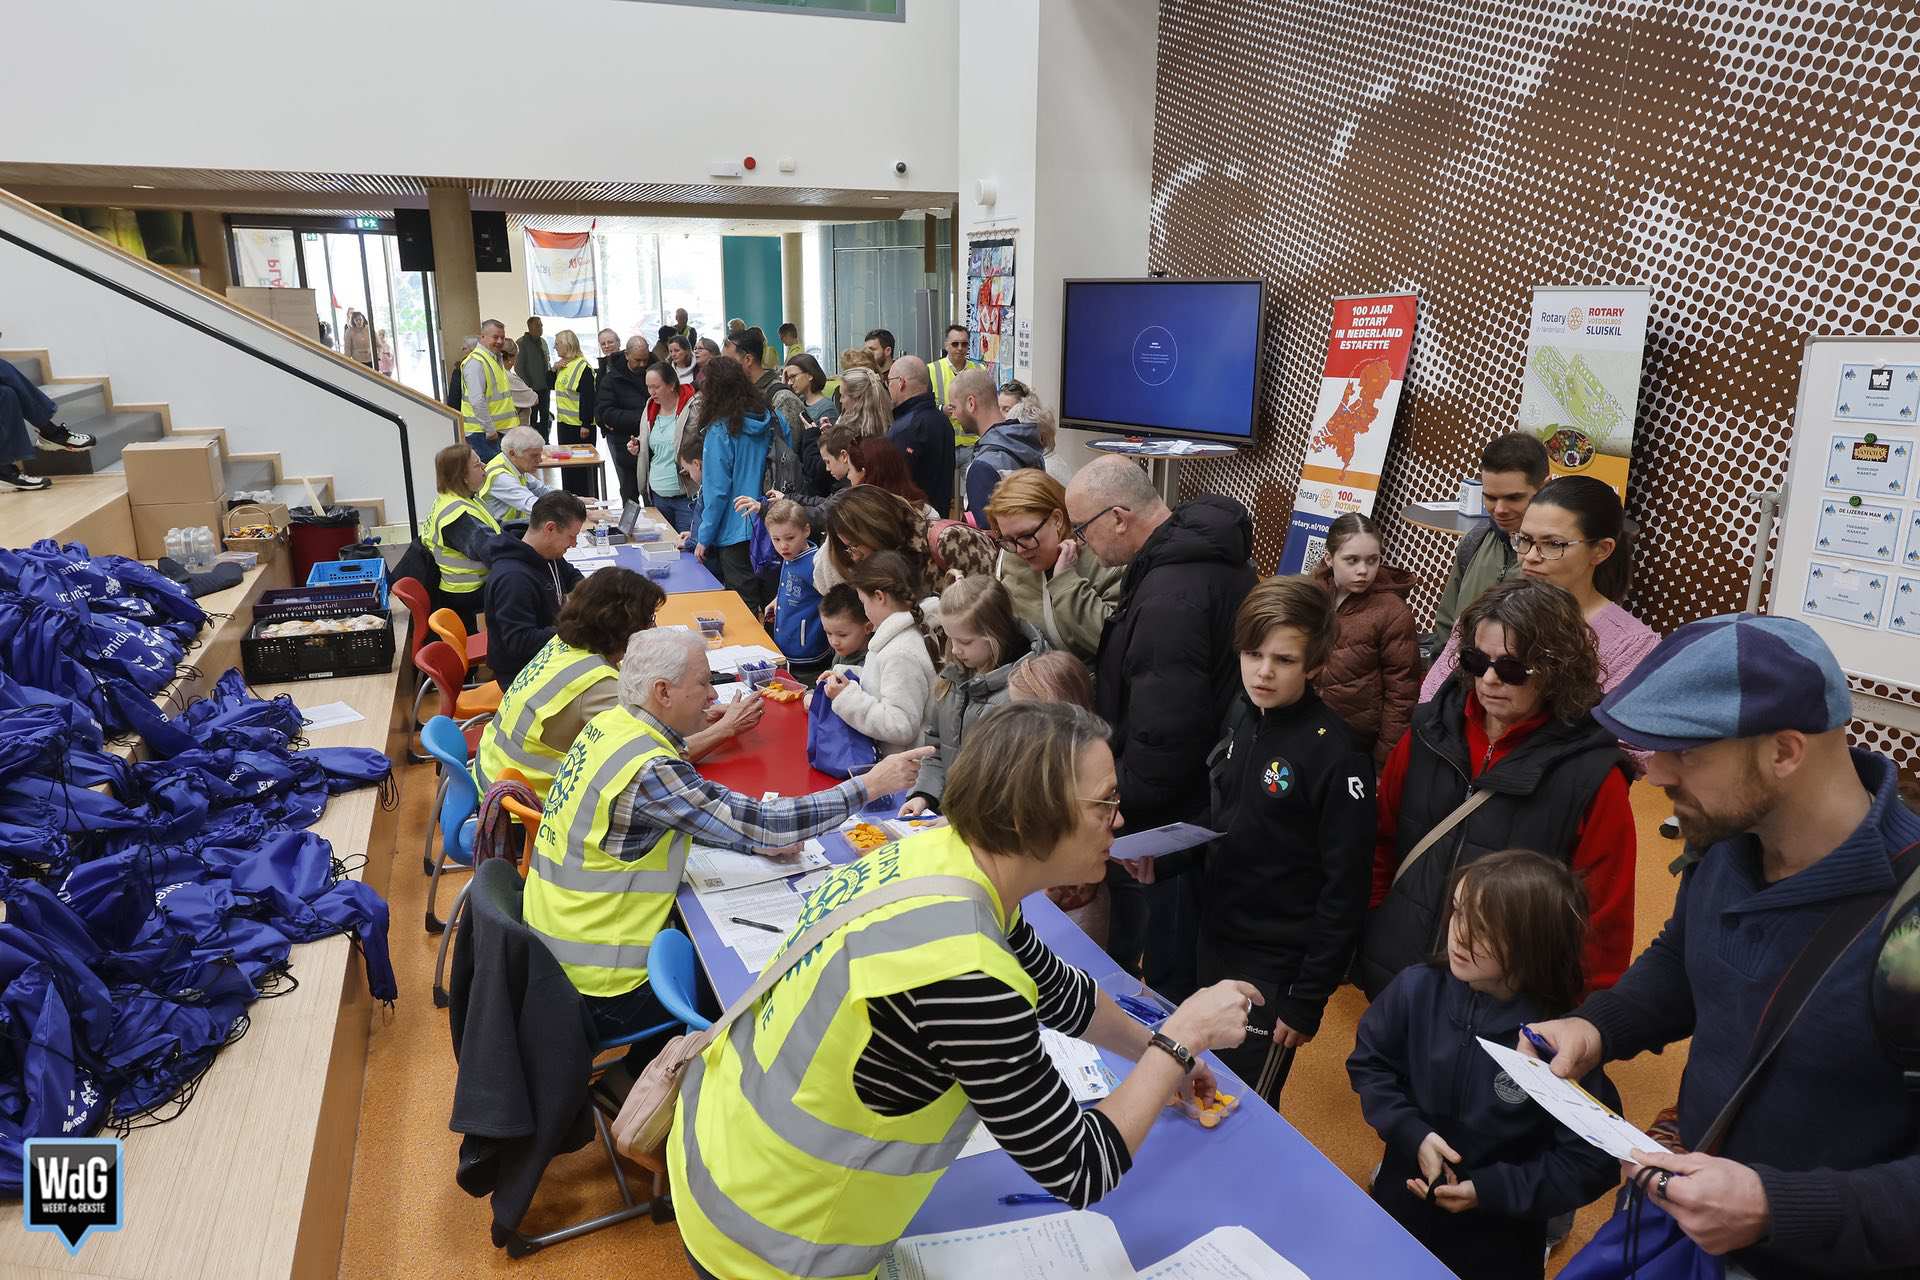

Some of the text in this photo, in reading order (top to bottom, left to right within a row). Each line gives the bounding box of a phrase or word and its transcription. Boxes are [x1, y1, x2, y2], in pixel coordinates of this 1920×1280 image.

[1352, 304, 1394, 316] 100 JAAR
[1352, 316, 1388, 327] ROTARY
[1541, 307, 1625, 325] Rotary ROTARY
[1335, 328, 1403, 339] IN NEDERLAND
[1586, 325, 1622, 336] SLUISKIL
[1340, 339, 1391, 350] ESTAFETTE
[1299, 488, 1319, 503] Rotary
[1338, 490, 1353, 502] 100
[1335, 501, 1360, 512] ROTARY
[286, 602, 338, 612] www.albert.nl
[1263, 775, 1272, 785] 20
[1265, 769, 1279, 780] DFO
[1245, 1025, 1269, 1036] didas
